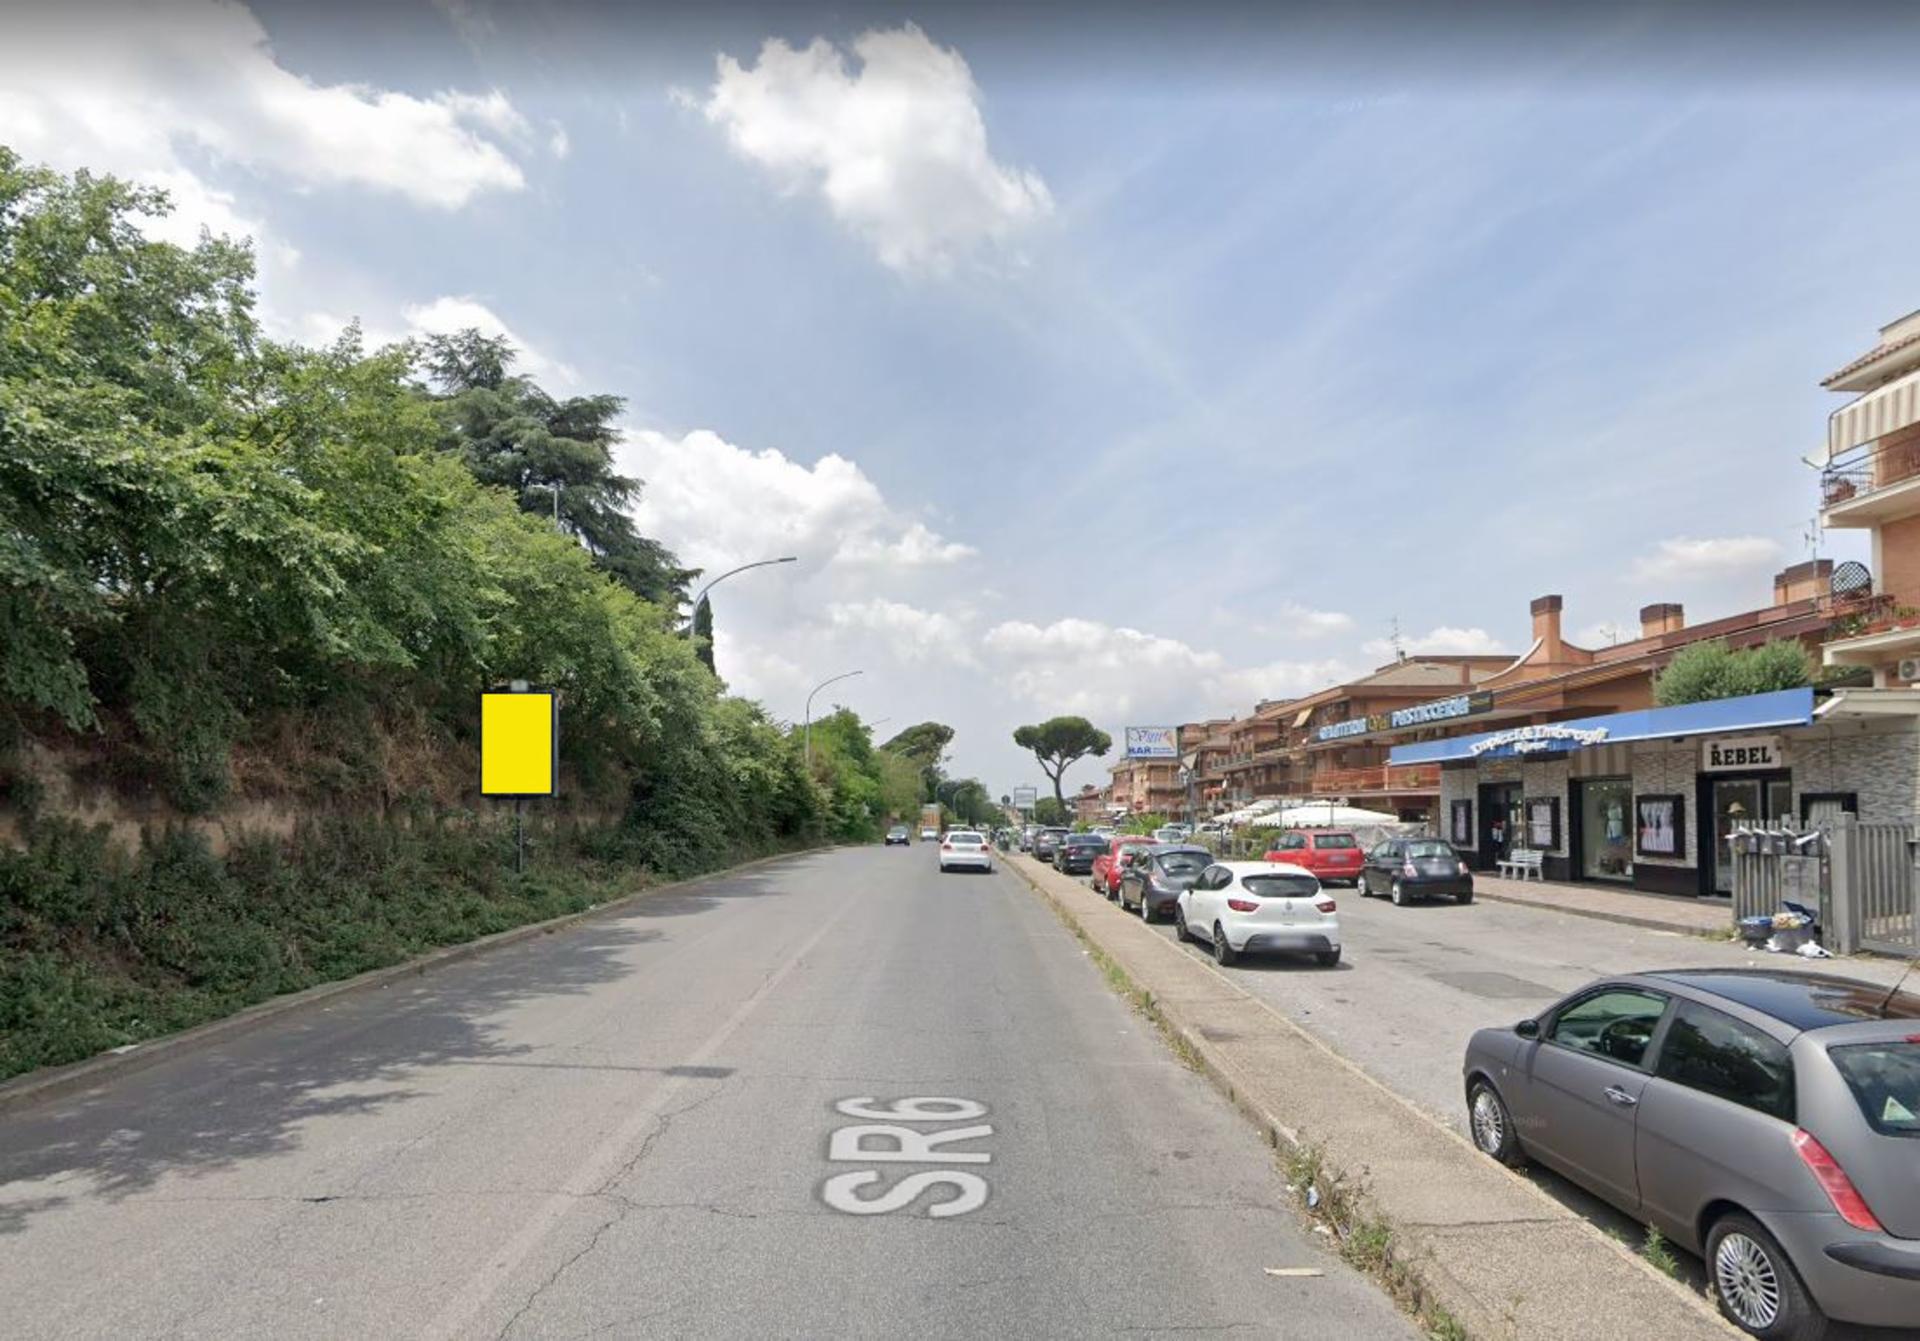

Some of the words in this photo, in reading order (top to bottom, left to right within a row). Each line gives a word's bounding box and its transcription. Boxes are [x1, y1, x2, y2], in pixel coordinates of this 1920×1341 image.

[1391, 697, 1469, 728] PASTICCERIA
[1128, 746, 1151, 754] BAR
[1711, 746, 1771, 766] REBEL
